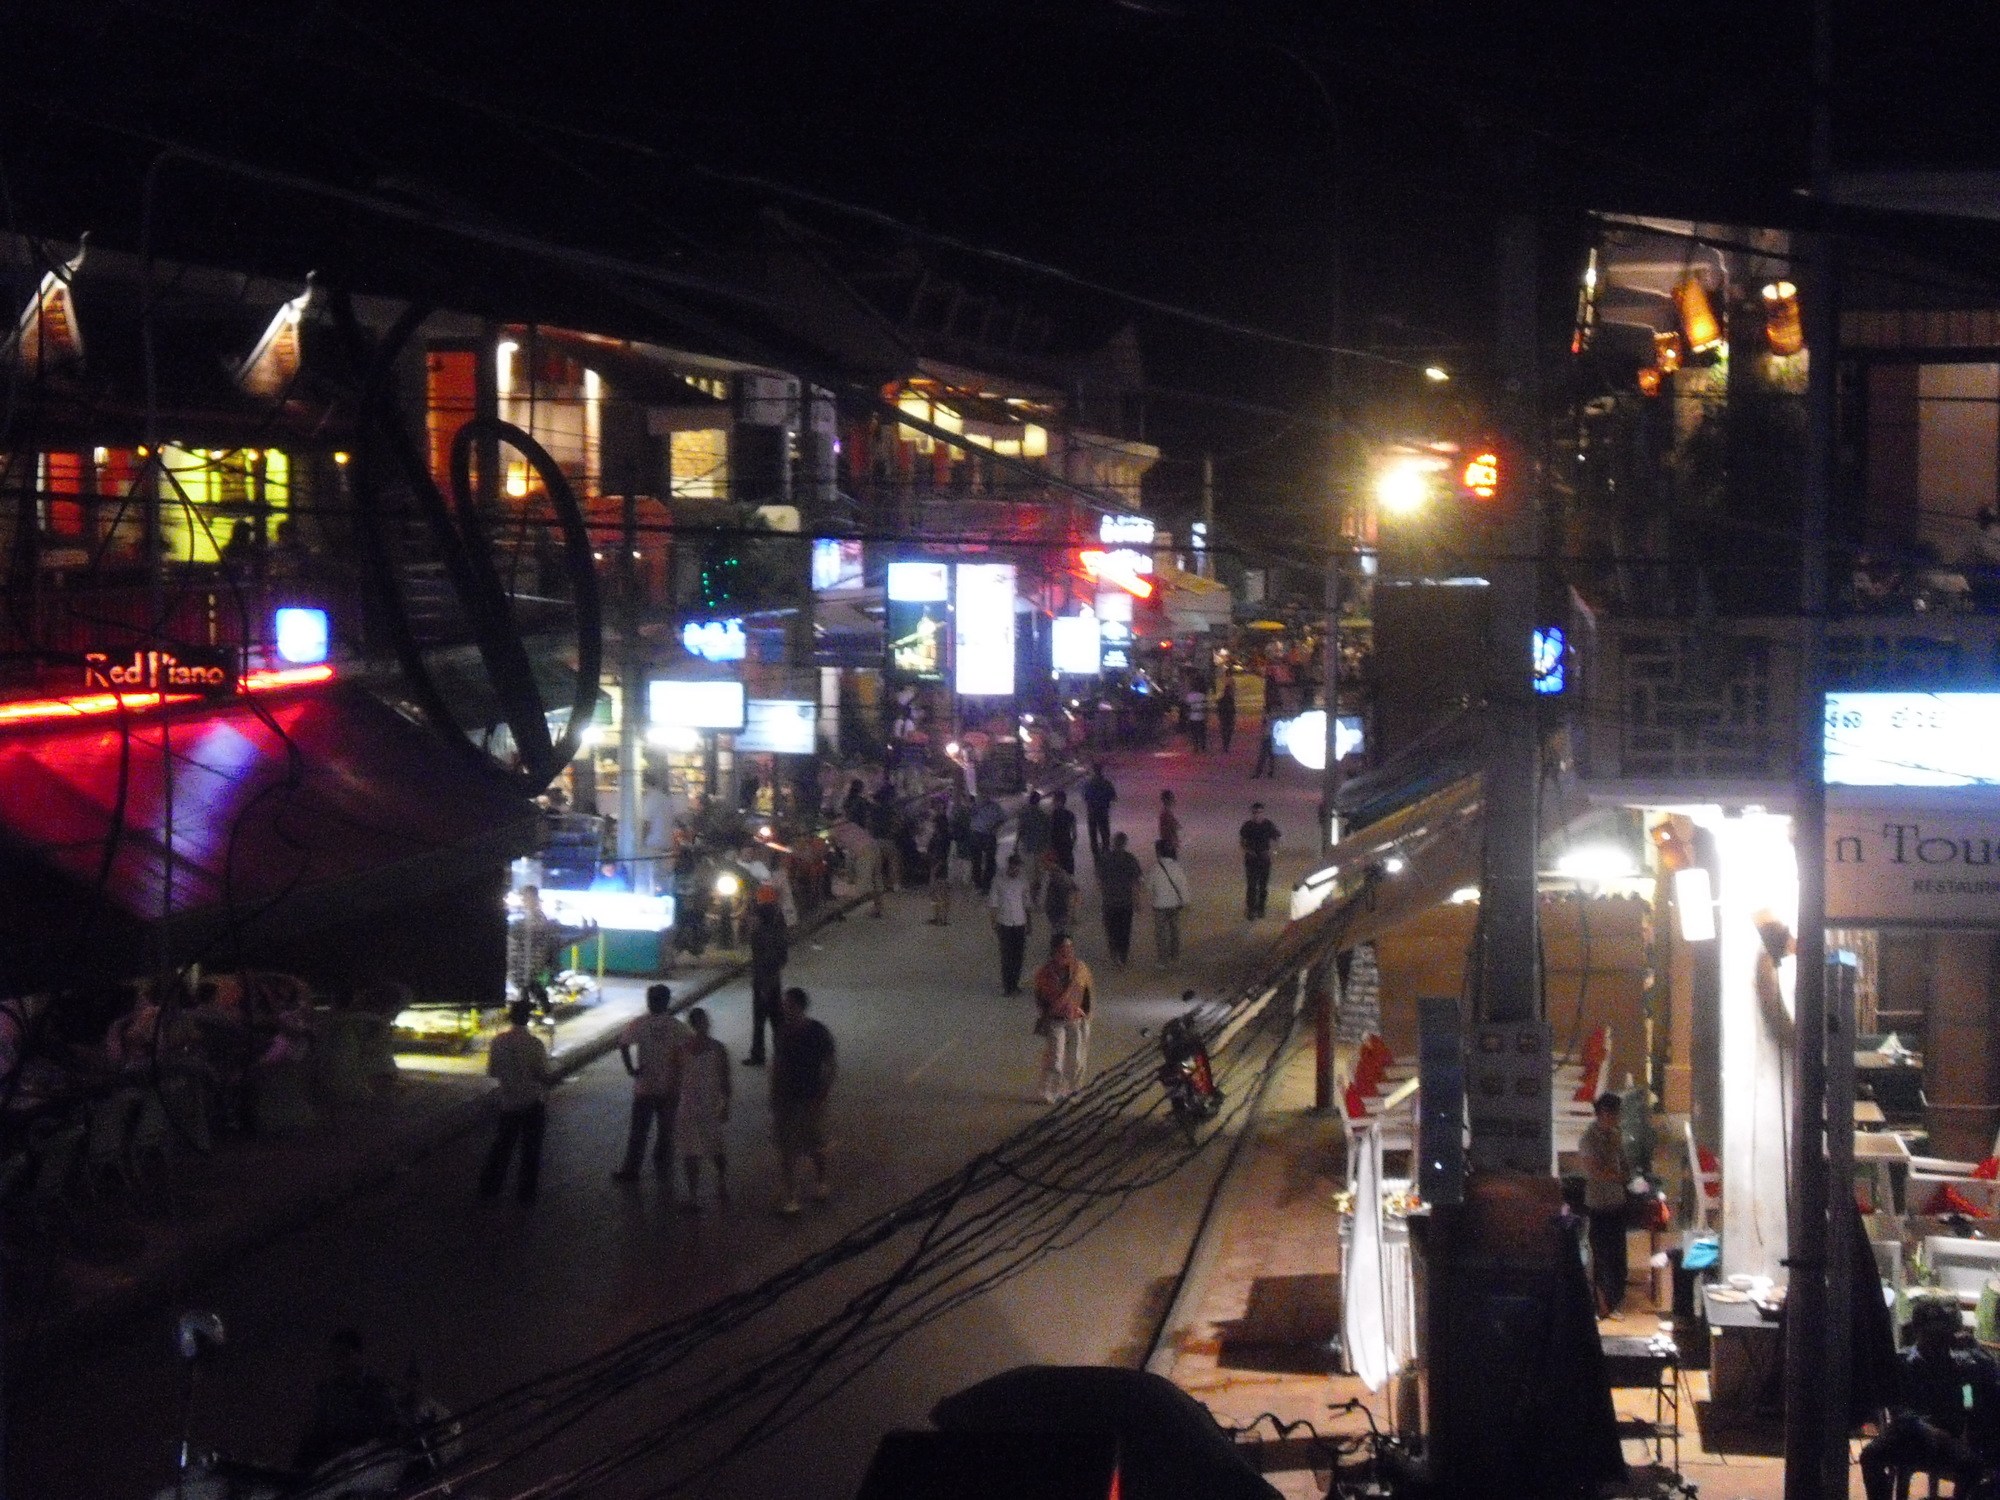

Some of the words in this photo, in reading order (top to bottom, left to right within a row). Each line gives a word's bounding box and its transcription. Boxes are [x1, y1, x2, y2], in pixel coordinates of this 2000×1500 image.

[85, 651, 142, 687] Red
[148, 651, 224, 688] Piano
[1836, 835, 1864, 864] n
[1883, 823, 2000, 866] Tou
